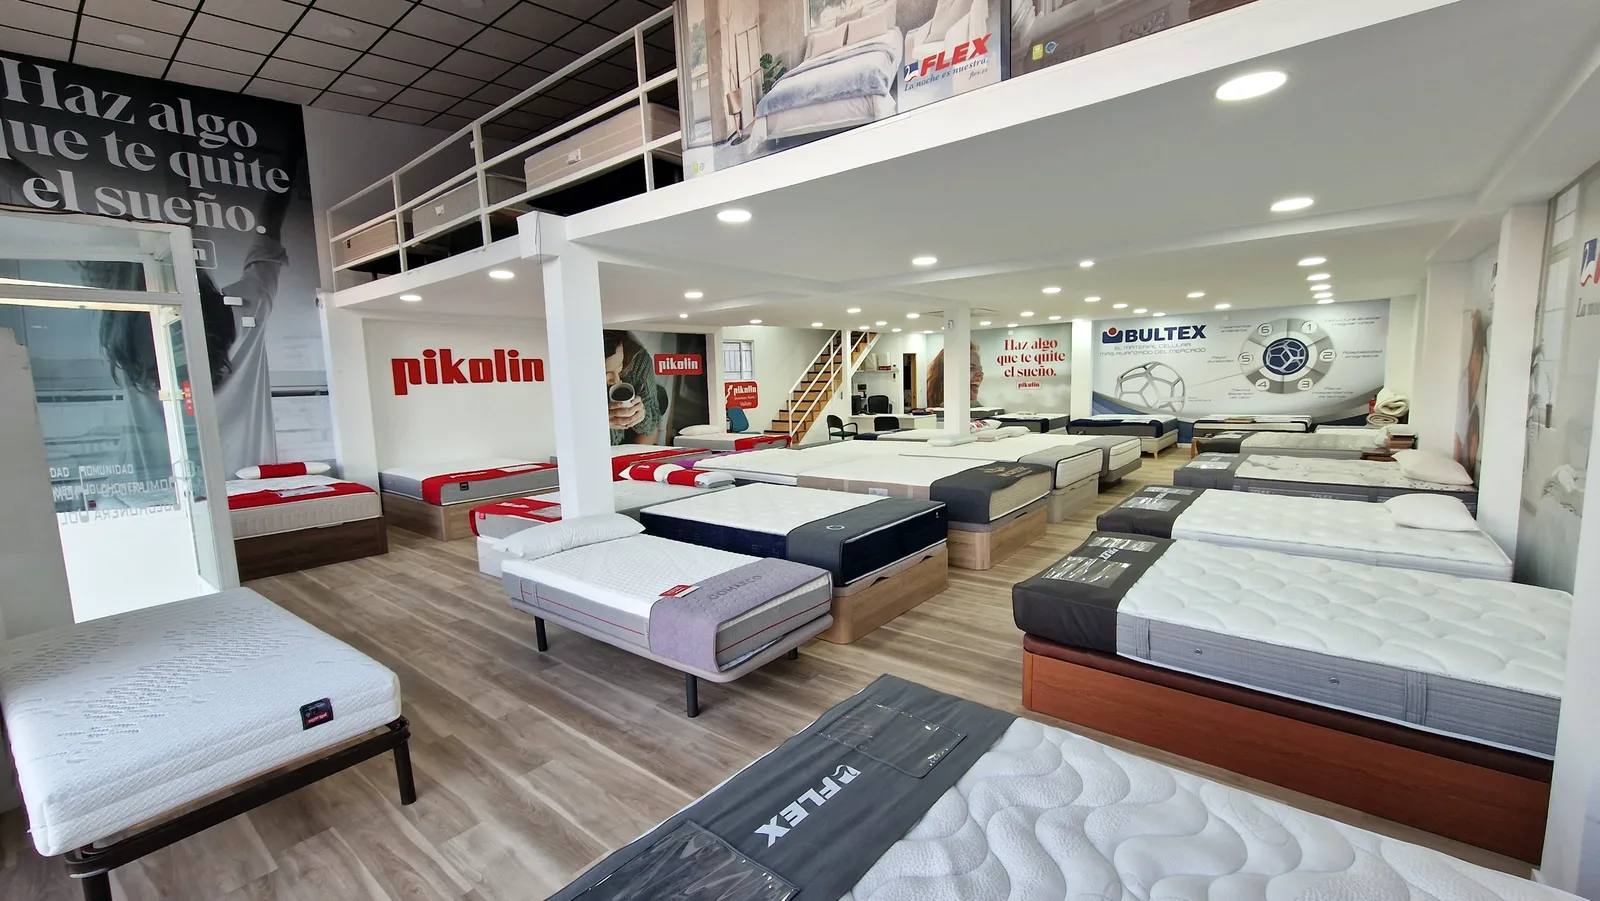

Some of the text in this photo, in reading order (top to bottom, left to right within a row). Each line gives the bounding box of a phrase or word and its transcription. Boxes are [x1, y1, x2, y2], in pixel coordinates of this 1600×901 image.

[920, 33, 991, 77] FLEX
[904, 57, 989, 92] La noche es nuestra.
[0, 56, 258, 149] Haz algo
[101, 130, 156, 172] te
[169, 151, 290, 194] quite
[22, 169, 267, 234] el sueño.
[1125, 325, 1207, 343] BULTEX
[1261, 325, 1270, 334] 6
[1004, 337, 1058, 352] Haz algo
[996, 350, 1066, 366] que te quite
[1242, 354, 1251, 363] 5
[1322, 351, 1333, 360] 2
[391, 348, 545, 396] pikolin
[658, 357, 698, 373] pikolin
[1004, 365, 1057, 377] el sueño.
[733, 385, 757, 397] pikolin
[1018, 381, 1040, 389] pikolin
[1257, 380, 1267, 388] 4
[1301, 380, 1310, 389] 3
[754, 776, 842, 848] FLEX
